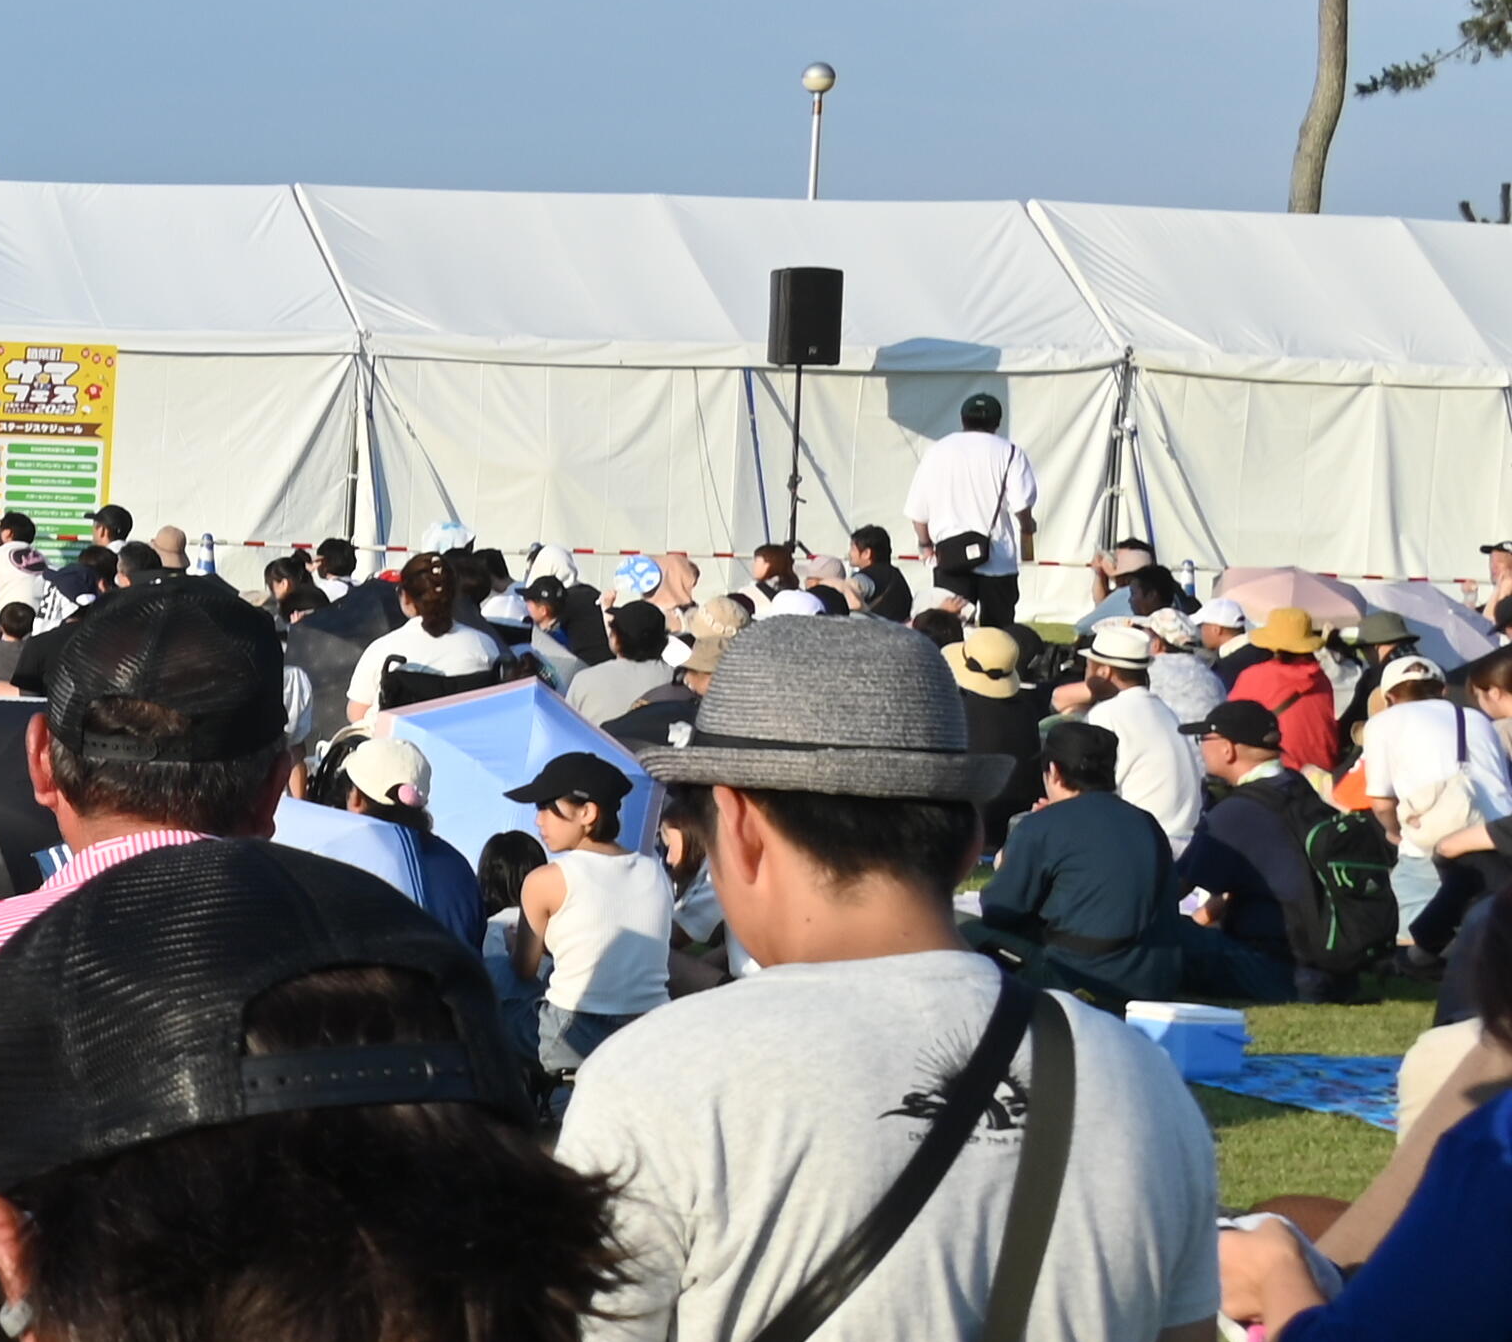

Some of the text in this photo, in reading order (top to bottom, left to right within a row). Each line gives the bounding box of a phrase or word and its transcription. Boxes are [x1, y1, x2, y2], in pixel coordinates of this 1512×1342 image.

[0, 422, 84, 435] ステージスケジュール
